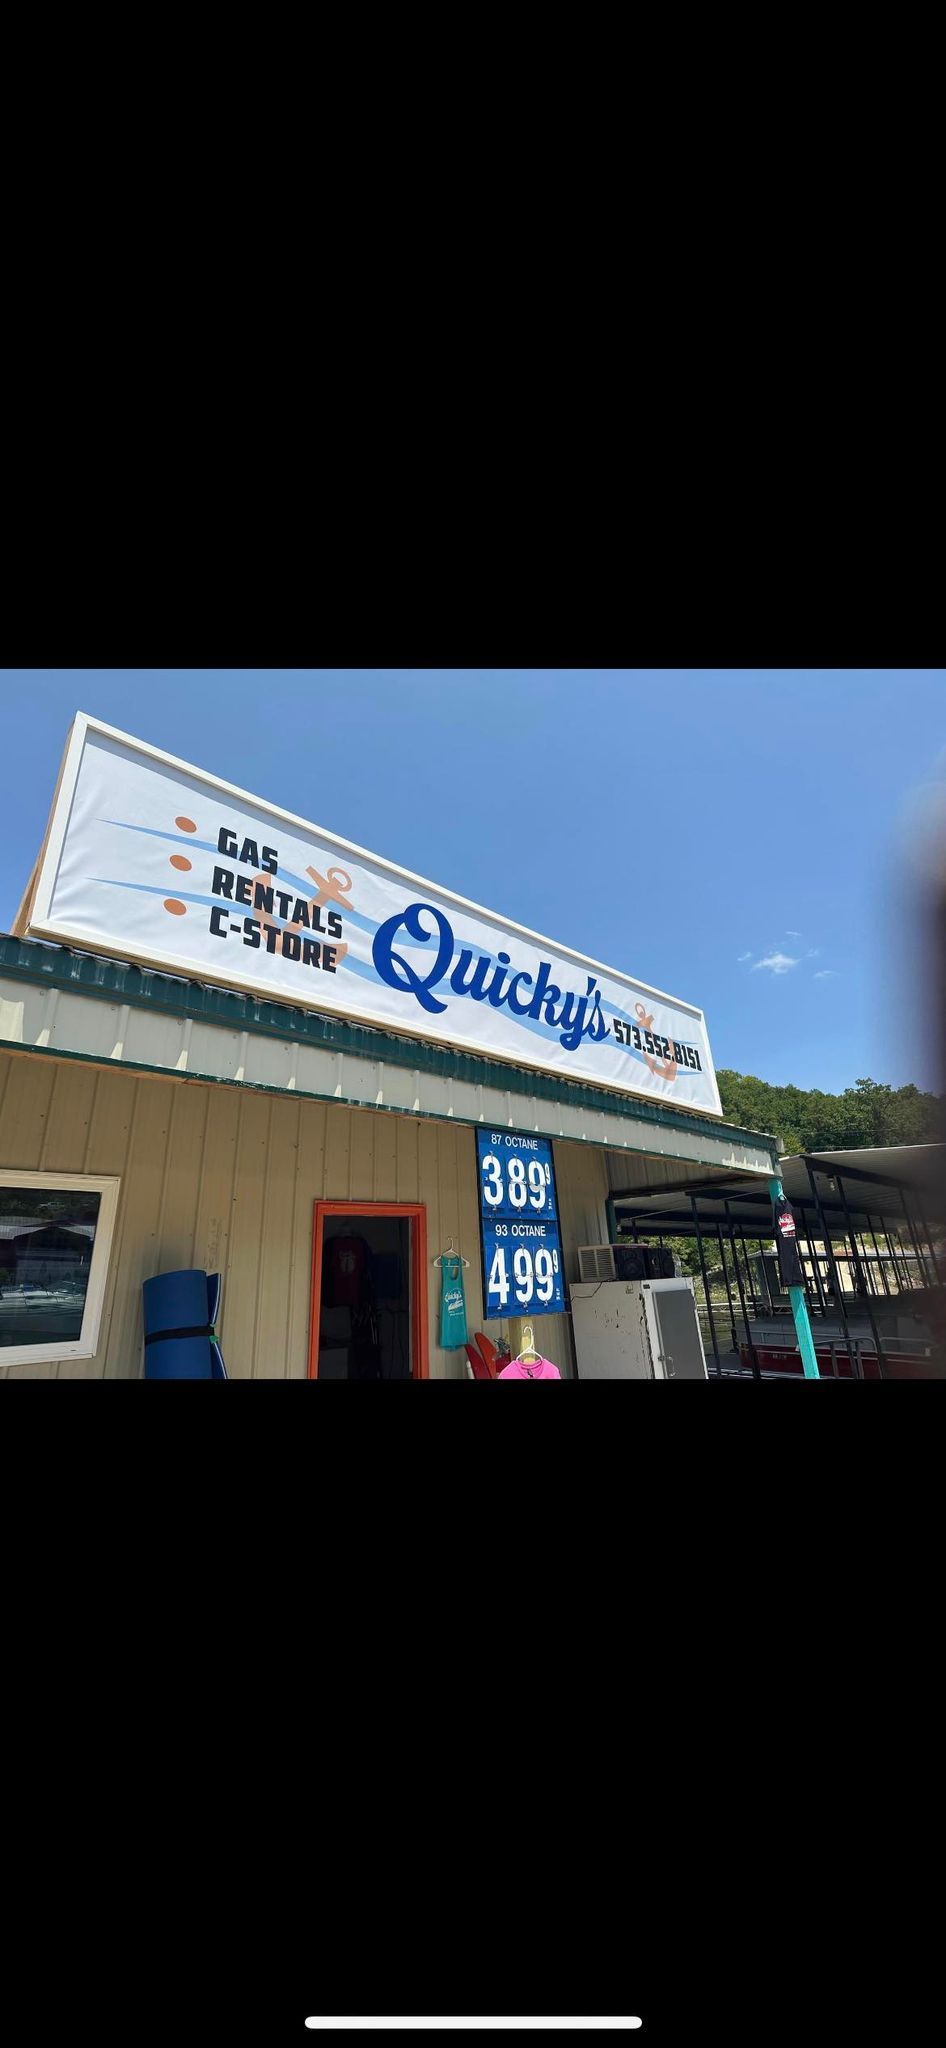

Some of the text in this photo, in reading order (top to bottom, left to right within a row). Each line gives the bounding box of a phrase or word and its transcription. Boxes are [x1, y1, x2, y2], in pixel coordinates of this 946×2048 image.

[217, 827, 278, 875] GAS
[211, 865, 342, 939] RENTALS
[209, 905, 337, 974] C-STORE
[371, 902, 611, 1051] Quicky's
[613, 1018, 702, 1071] 573.552.8151
[491, 1133, 539, 1151] 87 OCTANE
[495, 1224, 547, 1237] 93 OCTANE
